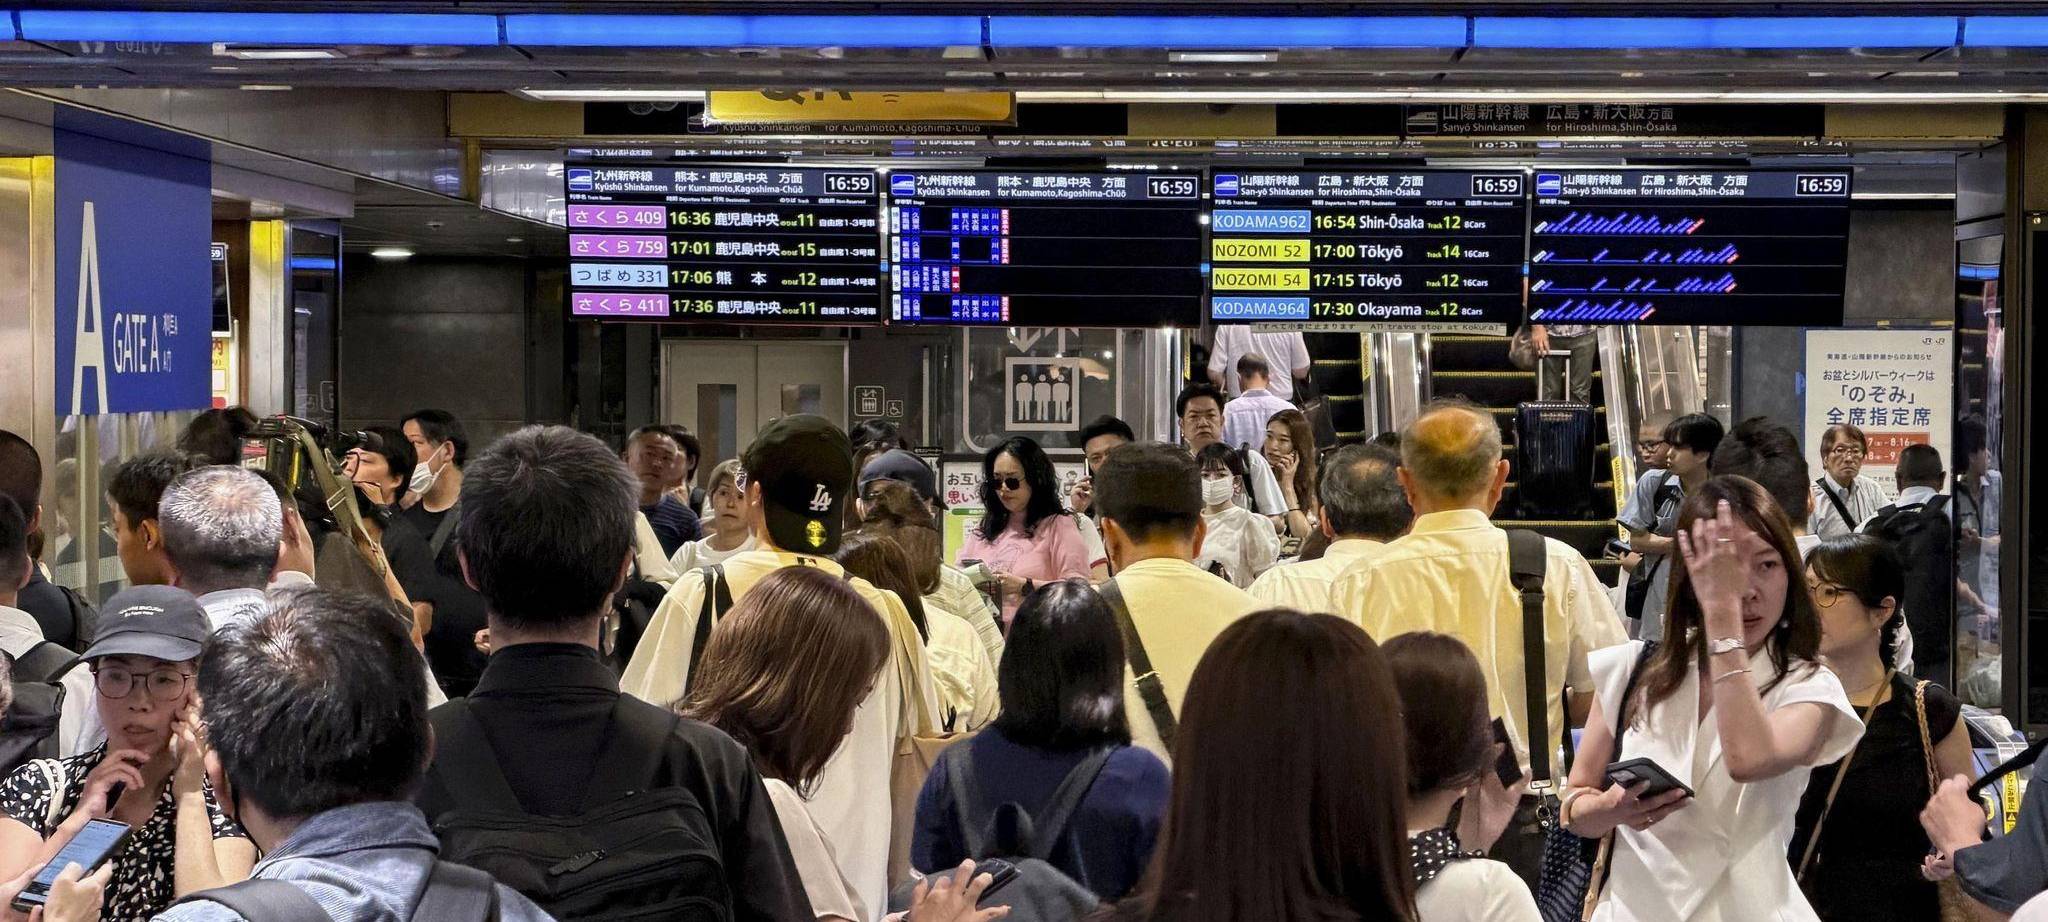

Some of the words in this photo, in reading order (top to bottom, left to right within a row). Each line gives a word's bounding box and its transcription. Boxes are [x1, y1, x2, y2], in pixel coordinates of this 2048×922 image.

[1443, 104, 1530, 120] 山陽新幹線
[1547, 104, 1645, 120] 広島・新大阪
[1648, 108, 1673, 120] 方面
[1473, 122, 1525, 132] Shinkansen
[1547, 122, 1561, 132] for
[594, 170, 653, 182] 九州新幹線
[674, 171, 768, 183] 熊本・鹿児島中央
[779, 173, 803, 184] 方面
[828, 177, 870, 191] 16:59
[917, 175, 976, 187] 九州新幹線
[997, 176, 1091, 188] 熊本・鹿児島中央
[1102, 176, 1126, 189] 方面
[1241, 175, 1299, 187] 山陽新幹線
[1318, 175, 1388, 187] 広島・新大阪
[1400, 175, 1424, 187] 方面
[1563, 174, 1623, 186] 山陽新幹線
[1641, 174, 1713, 186] 広島・新大阪
[1723, 175, 1747, 187] 方面
[624, 183, 668, 192] Shinkansen
[675, 184, 687, 192] for
[947, 187, 990, 196] Shinkansen
[997, 188, 1009, 197] for
[1151, 181, 1193, 195] 16:59
[1269, 187, 1314, 197] Shinkansen
[1318, 187, 1330, 197] for
[1475, 178, 1518, 193] 16:59
[1591, 186, 1637, 196] Shinkansen
[1641, 187, 1654, 195] for
[1800, 179, 1843, 192] 16:59
[575, 210, 630, 223] さくら
[634, 211, 662, 224] 409
[670, 212, 711, 225] 16:36
[714, 212, 780, 226] 鹿児島中央
[798, 214, 814, 226] 11
[1213, 214, 1307, 229] KODAMA962
[1314, 215, 1356, 229] 16:54
[1359, 213, 1424, 229] Shin-Ōsaka
[1443, 216, 1460, 229] 12
[1464, 220, 1486, 229] 8Cars
[576, 240, 631, 252] さくら
[635, 240, 663, 254] 759
[670, 242, 711, 254] 17:01
[715, 242, 780, 256] 鹿児島中央
[798, 243, 816, 256] 15
[1215, 245, 1277, 258] NOZOMI
[1284, 245, 1301, 258] 52
[1314, 245, 1355, 258] 17:00
[1359, 244, 1403, 260] Tōkyō
[1442, 245, 1460, 258] 14
[1463, 249, 1489, 258] 16Cars
[577, 269, 631, 282] つばめ
[636, 270, 663, 283] 331
[671, 271, 712, 284] 17:06
[716, 271, 767, 285] 熊本
[798, 273, 816, 286] 12
[1215, 274, 1277, 287] NOZOMI
[1283, 274, 1302, 287] 54
[1313, 274, 1354, 287] 17:15
[1359, 273, 1402, 289] Tōkyō
[1441, 274, 1459, 287] 12
[1463, 279, 1488, 287] 16Cars
[72, 201, 109, 415] A
[578, 299, 632, 311] さくら
[638, 299, 664, 312] 411
[673, 300, 714, 313] 17:36
[717, 300, 782, 314] 鹿児島中央
[799, 302, 816, 314] 11
[1213, 302, 1306, 315] KODAMA964
[1313, 303, 1354, 316] 17:30
[1358, 302, 1422, 318] Okayama
[1440, 303, 1458, 315] 12
[1461, 307, 1483, 315] 8Cars
[113, 312, 147, 373] GATE
[150, 315, 159, 373] A
[1823, 370, 1935, 382] お盆とシルバーウィークは
[1841, 385, 1915, 404] 「のぞみ」
[1826, 407, 1931, 427] 全席指定席
[808, 484, 833, 511] LA
